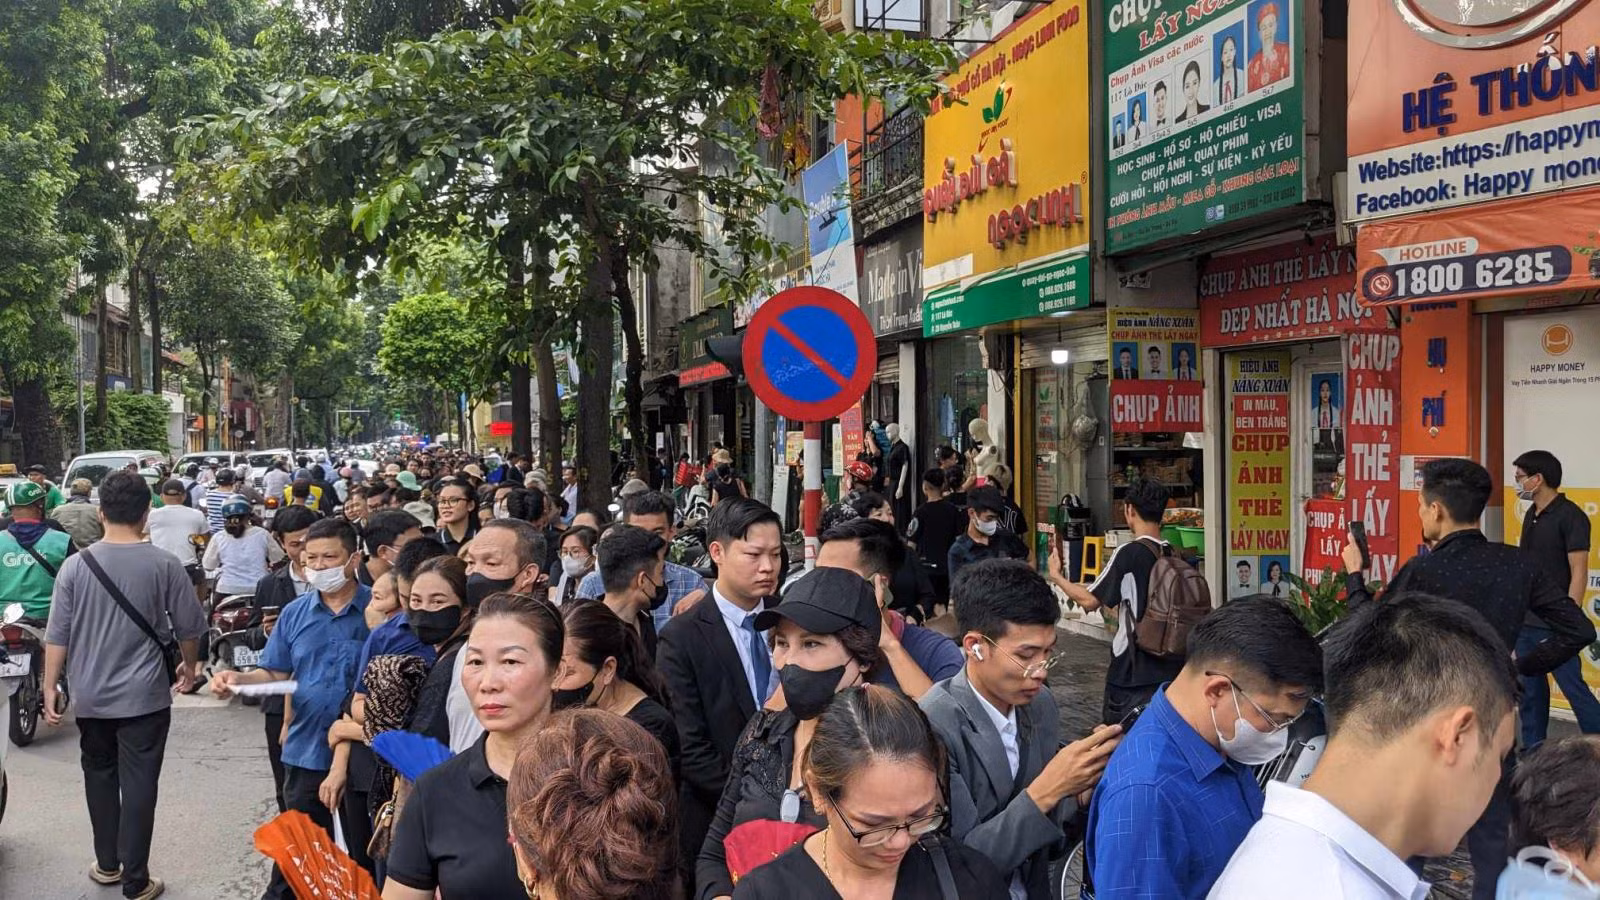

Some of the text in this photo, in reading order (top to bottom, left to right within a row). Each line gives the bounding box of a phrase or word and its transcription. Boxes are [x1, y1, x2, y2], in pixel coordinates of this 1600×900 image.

[1011, 37, 1035, 65] NGỌC
[1036, 20, 1056, 49] LINH
[1056, 5, 1080, 35] FOOD
[1138, 11, 1182, 51] LẤY
[1110, 72, 1129, 88] Chụp
[1131, 63, 1146, 77] Ảnh
[1148, 55, 1164, 72] Visa
[1262, 86, 1274, 97] 5x7
[1402, 31, 1600, 136] HỆ THỐN
[1111, 89, 1122, 103] 117
[1117, 102, 1282, 176] HỌC SINH HỒ SƠ HỘ CHIẾU VISA
[1141, 132, 1250, 182] CHỤP ẢNH QUAY PHIM
[1131, 183, 1146, 201] HỎI
[1153, 177, 1169, 194] HỘI
[1171, 169, 1193, 187] NGHỊ
[1218, 152, 1242, 172] KIỆN
[1270, 132, 1293, 151] YẾU
[1356, 180, 1457, 215] Facebook:
[1463, 166, 1534, 198] Happy
[1200, 270, 1236, 298] CHỤP
[1308, 240, 1341, 278] LẤY
[1398, 240, 1468, 261] HOTLINE
[868, 264, 896, 305] Made
[1395, 252, 1554, 297] 1800 6285
[1220, 306, 1250, 337] ĐẸP
[1254, 288, 1301, 330] NHẤT
[1306, 287, 1332, 324] HÀ
[1348, 333, 1400, 382] CHỤP
[1530, 362, 1586, 373] HAPPY MONEY
[1113, 384, 1200, 430] CHỤP ẢNH
[1236, 412, 1286, 428] ĐEN TRẮNG
[1243, 400, 1253, 411] IN
[1351, 374, 1393, 426] ẢNH
[1232, 434, 1290, 457] CHỤP
[1351, 430, 1391, 481] THẺ
[1238, 460, 1283, 484] ẢNH
[1238, 491, 1283, 516] THẺ
[1307, 510, 1335, 533] CHỤP
[1257, 528, 1290, 551] NGAY
[1320, 534, 1342, 556] LẤY
